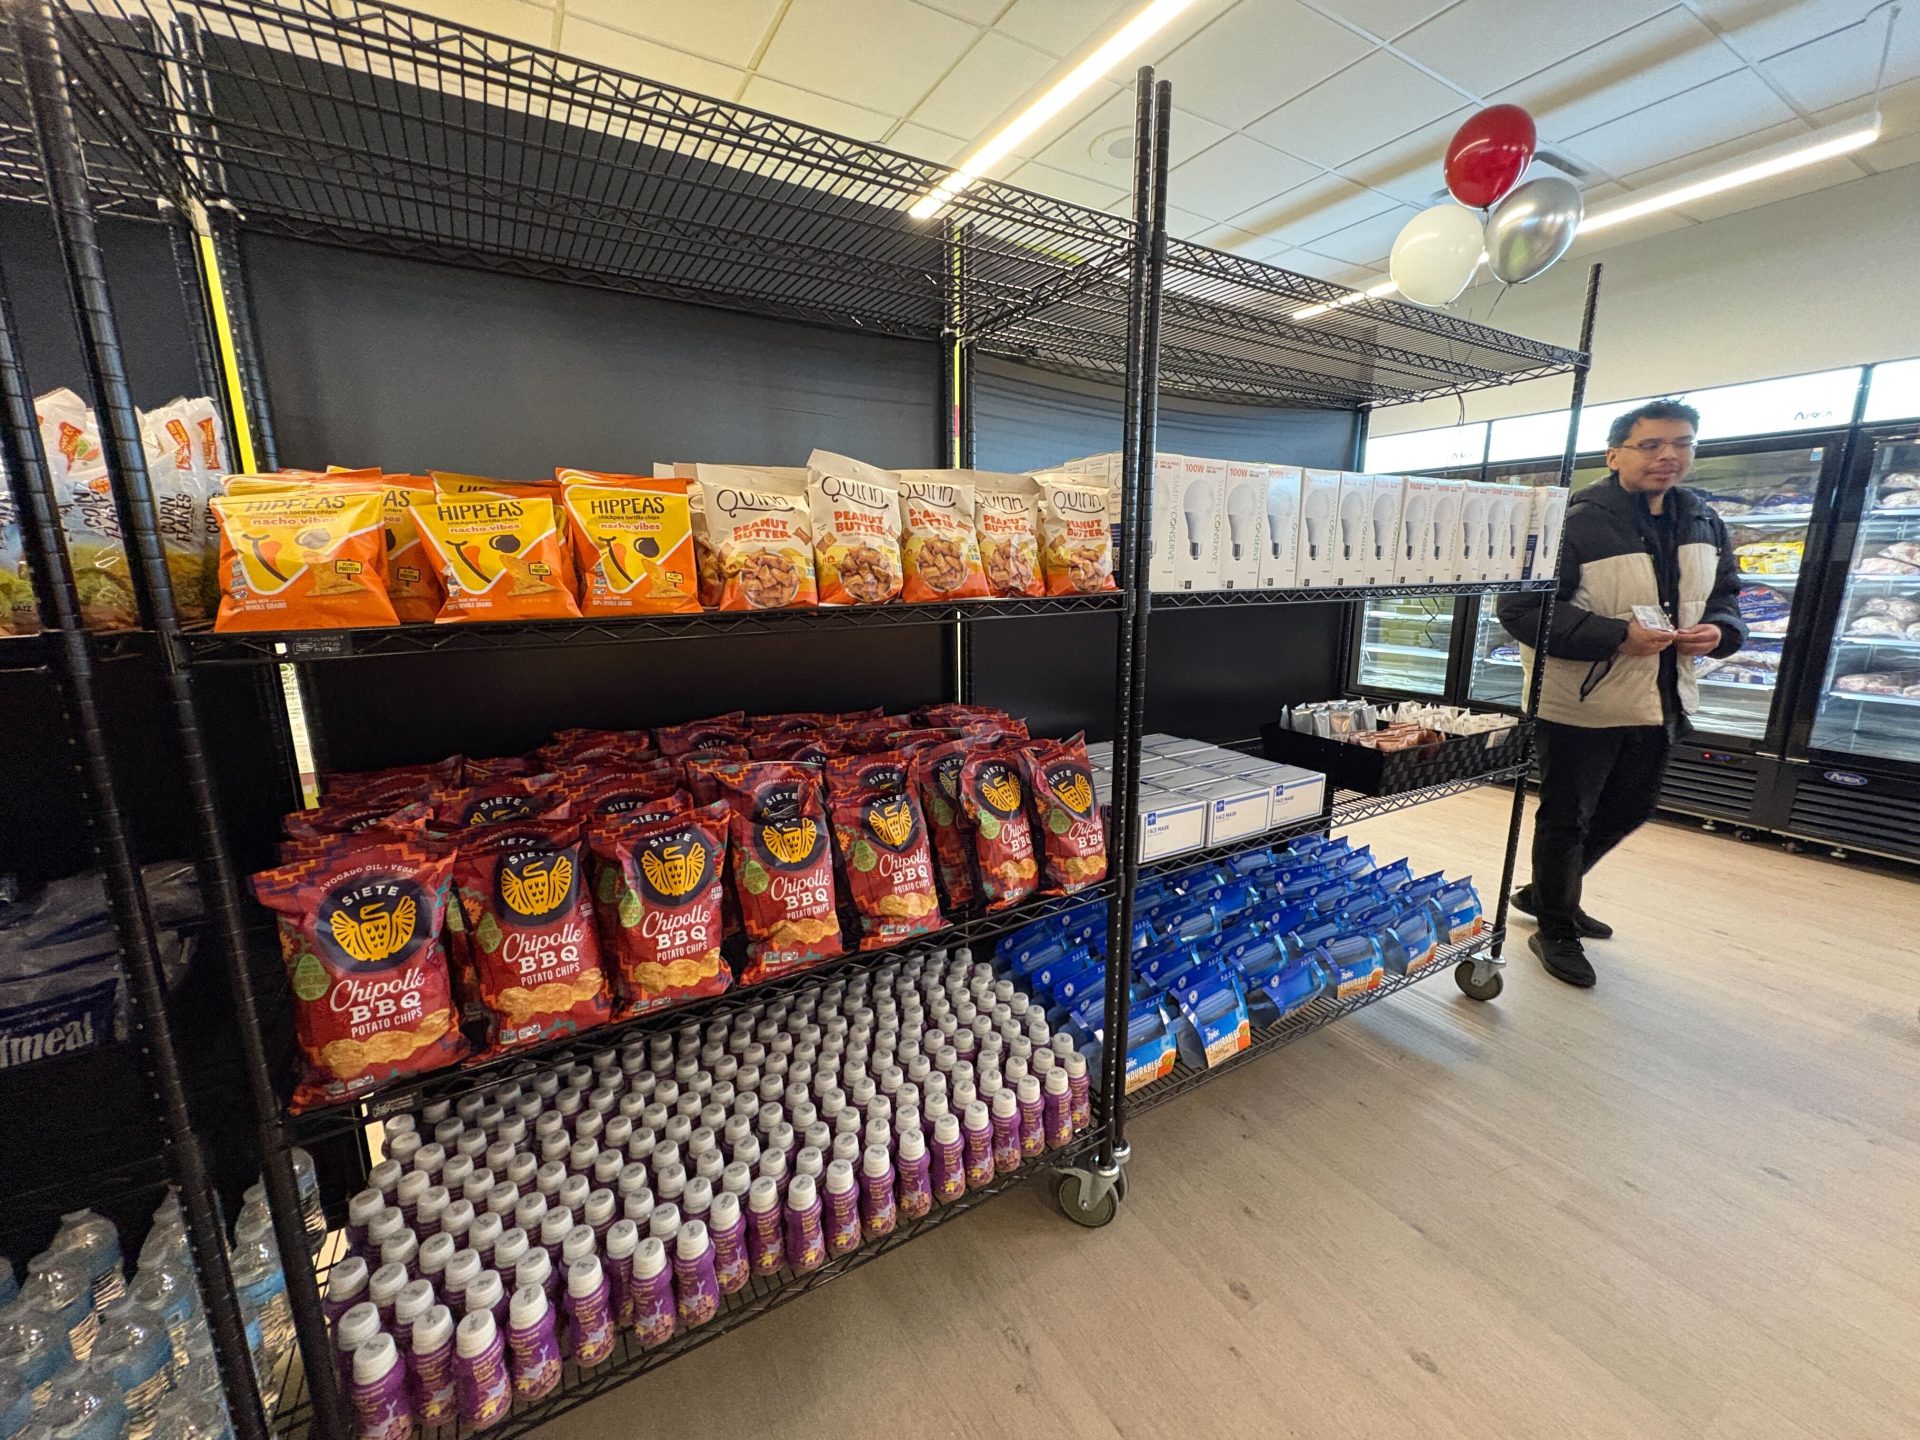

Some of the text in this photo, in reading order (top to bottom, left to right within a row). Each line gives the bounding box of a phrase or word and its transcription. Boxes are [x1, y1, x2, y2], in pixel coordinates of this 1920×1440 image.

[1185, 464, 1204, 472] 100W
[1230, 468, 1248, 478] 100W
[245, 496, 346, 512] HIPPEAS
[438, 502, 524, 522] HIPPEAS
[591, 496, 664, 514] HIPPEAS
[160, 496, 177, 534] CORN
[176, 493, 192, 542] FLAKES
[252, 516, 296, 526] nacho
[834, 510, 884, 524] PEANUT
[733, 518, 788, 532] PEANUT
[835, 522, 886, 536] BUTTER
[984, 522, 1030, 534] BUTTER
[1066, 528, 1104, 539] BUTTER
[734, 528, 792, 542] BUTTER
[1168, 511, 1178, 564] CONSERVE
[1212, 514, 1222, 562] CONSERVE
[1253, 516, 1262, 562] CONSERVE
[699, 740, 728, 750] SIETE
[940, 758, 964, 772] SIETE
[982, 766, 1005, 780] SIETE
[868, 772, 898, 786] SIETE
[1050, 770, 1072, 786] SIETE
[480, 796, 522, 810] SIETE
[608, 802, 644, 812] SIETE
[766, 792, 798, 806] SIETE
[650, 833, 692, 848] SIETE
[1011, 832, 1032, 851] BBQ
[1078, 830, 1103, 848] BBQ
[880, 848, 930, 877] Chipotle
[320, 866, 363, 892] AVOCADO
[893, 865, 929, 885] BBQ
[770, 869, 831, 901] Chipotle
[894, 883, 915, 895] POTATO
[342, 885, 400, 906] SIETE
[784, 888, 828, 911] BBQ
[642, 904, 712, 938] Chipotle
[786, 904, 830, 920] POTATO CHIPS
[502, 923, 584, 963] Chipotle
[656, 925, 708, 950] BBQ
[518, 946, 580, 976] BBQ
[656, 941, 708, 962] POTATO CHIPS
[521, 962, 580, 986] POTATO CHIPS
[330, 966, 425, 1012] Chipotle
[350, 990, 422, 1025] BBQ
[351, 1008, 423, 1038] POTATO CHIPS
[1208, 1030, 1240, 1052] ENDURABLES
[1126, 1056, 1162, 1081] NDURABLES
